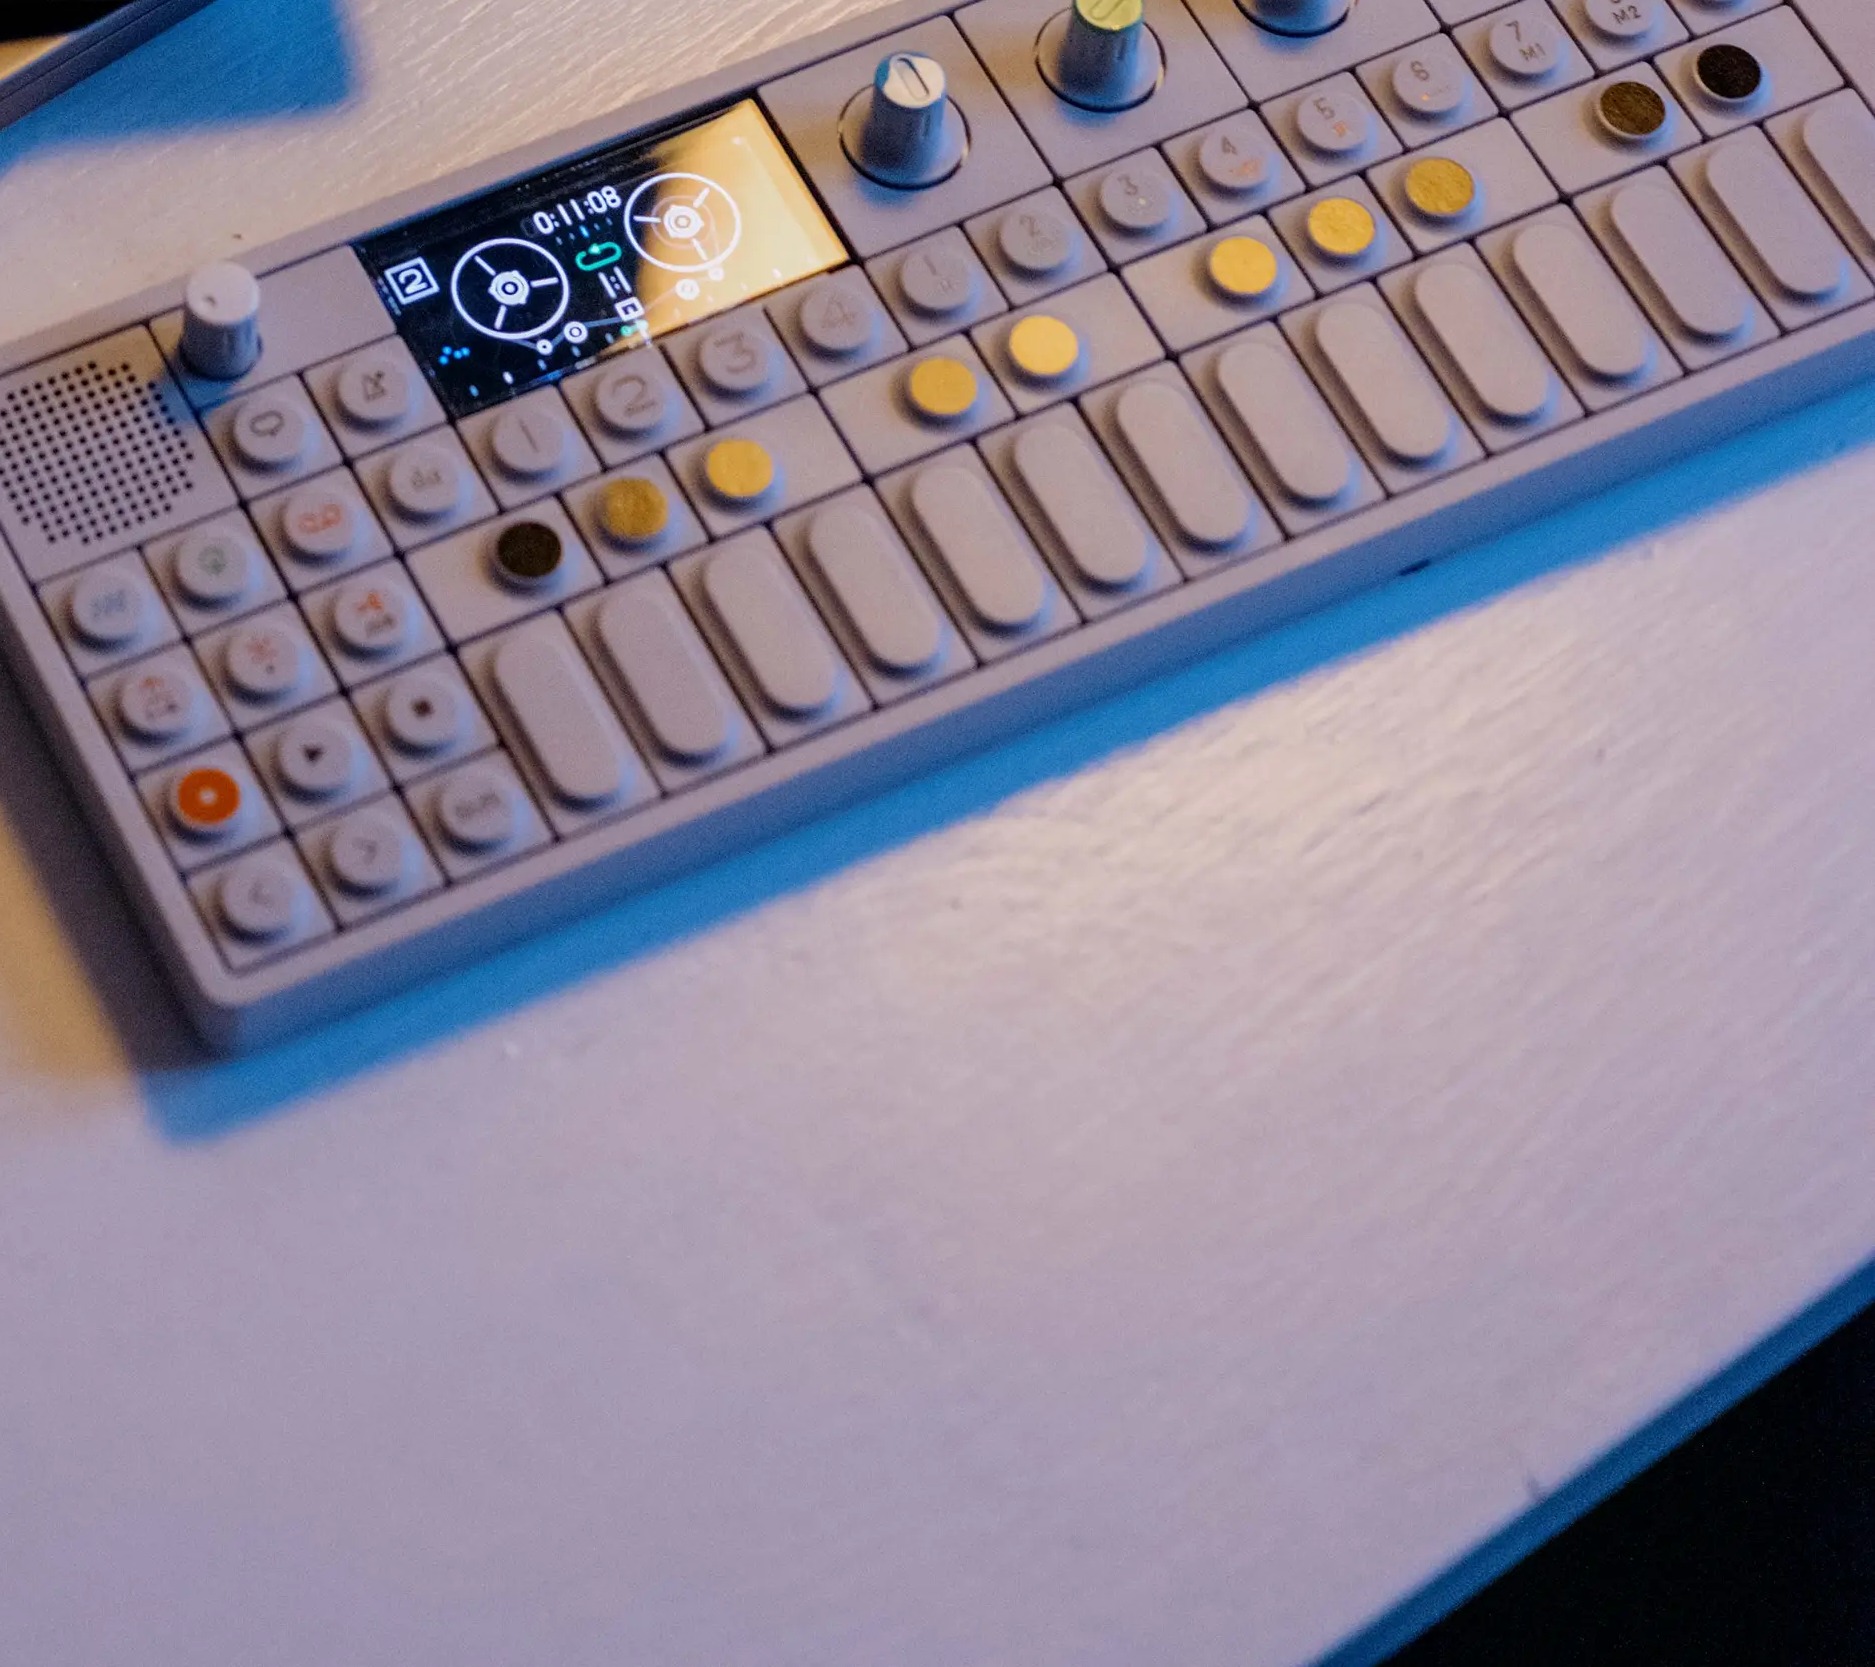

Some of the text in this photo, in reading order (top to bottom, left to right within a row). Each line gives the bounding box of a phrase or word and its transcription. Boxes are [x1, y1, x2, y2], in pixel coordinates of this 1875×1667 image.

[1505, 20, 1522, 43] 7
[532, 185, 622, 235] 0:11:08
[611, 375, 658, 418] 2
